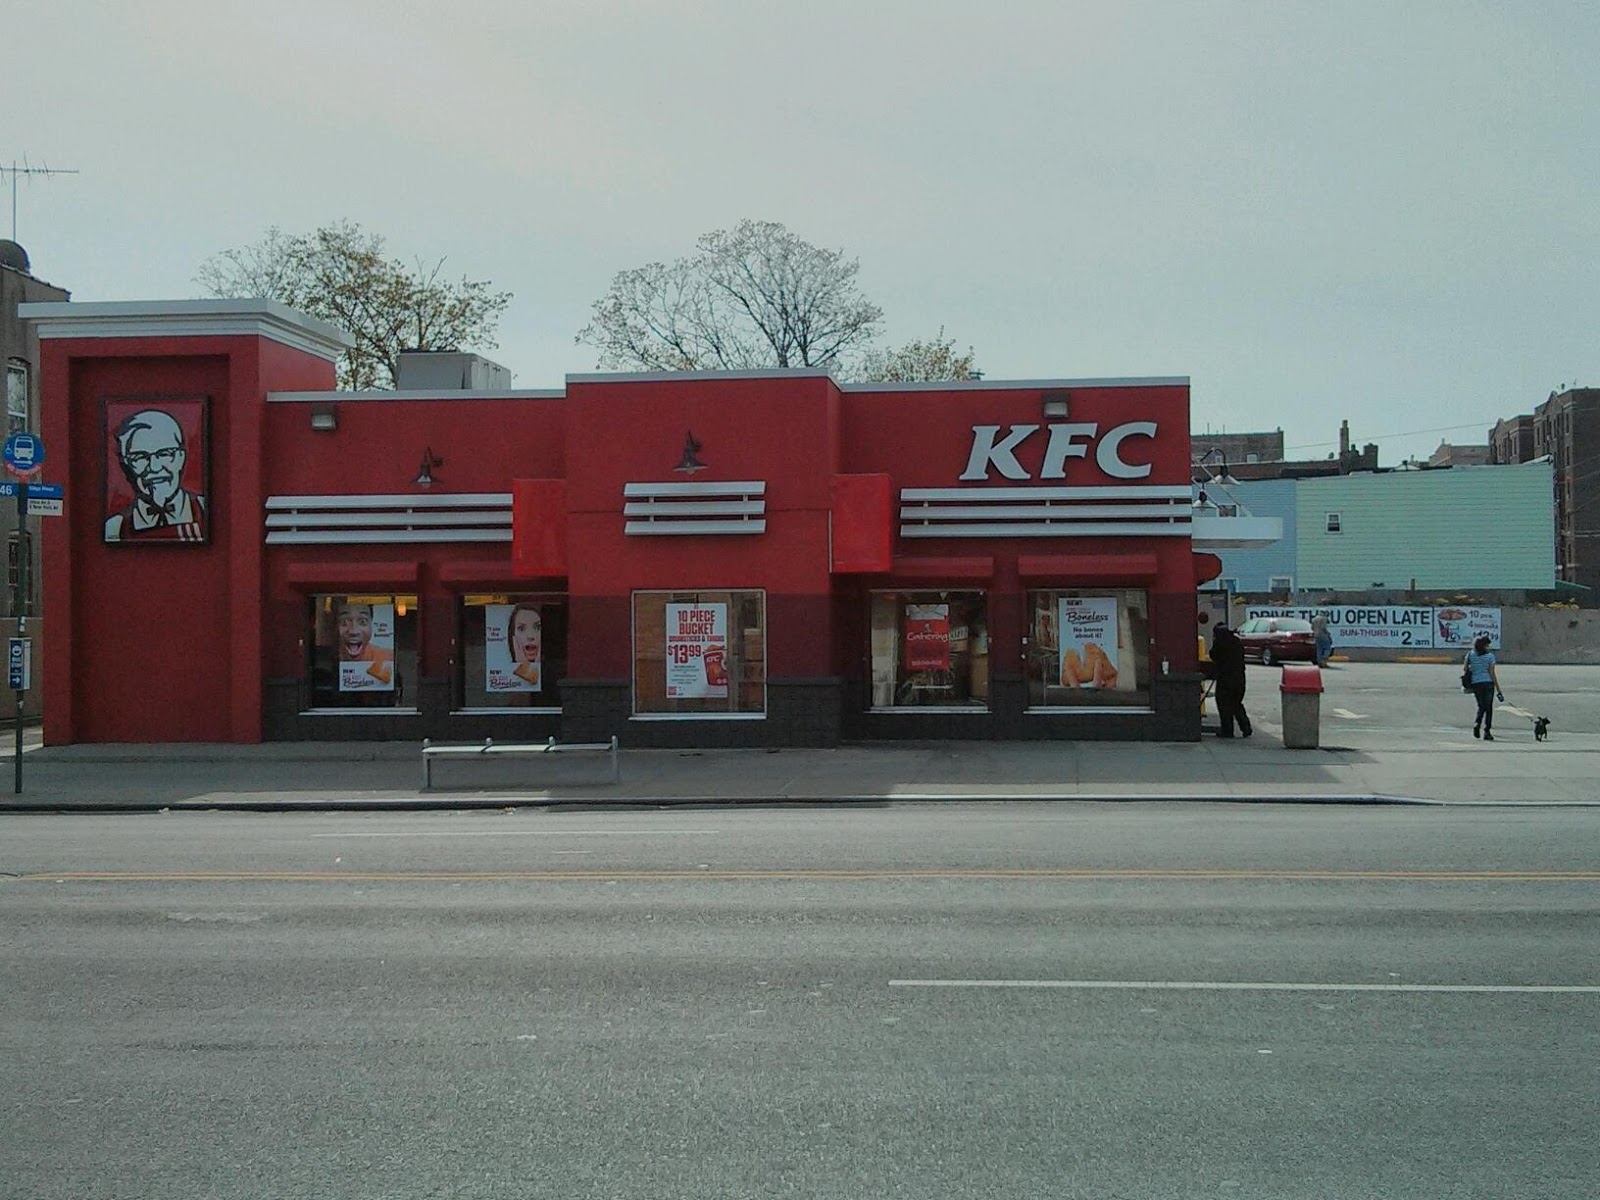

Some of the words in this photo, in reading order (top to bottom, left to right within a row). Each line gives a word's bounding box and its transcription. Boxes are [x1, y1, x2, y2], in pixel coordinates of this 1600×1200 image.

[958, 421, 1158, 480] KFC
[677, 610, 688, 622] 10
[690, 610, 715, 622] PIECE
[1066, 611, 1109, 624] Boneless
[1345, 609, 1387, 625] OPEN
[1393, 610, 1430, 625] LATE
[1469, 610, 1479, 618] 10
[679, 623, 714, 634] BUCKET
[1340, 629, 1389, 637] SUN-THURS
[907, 631, 948, 642] Catering
[1401, 631, 1412, 645] 2
